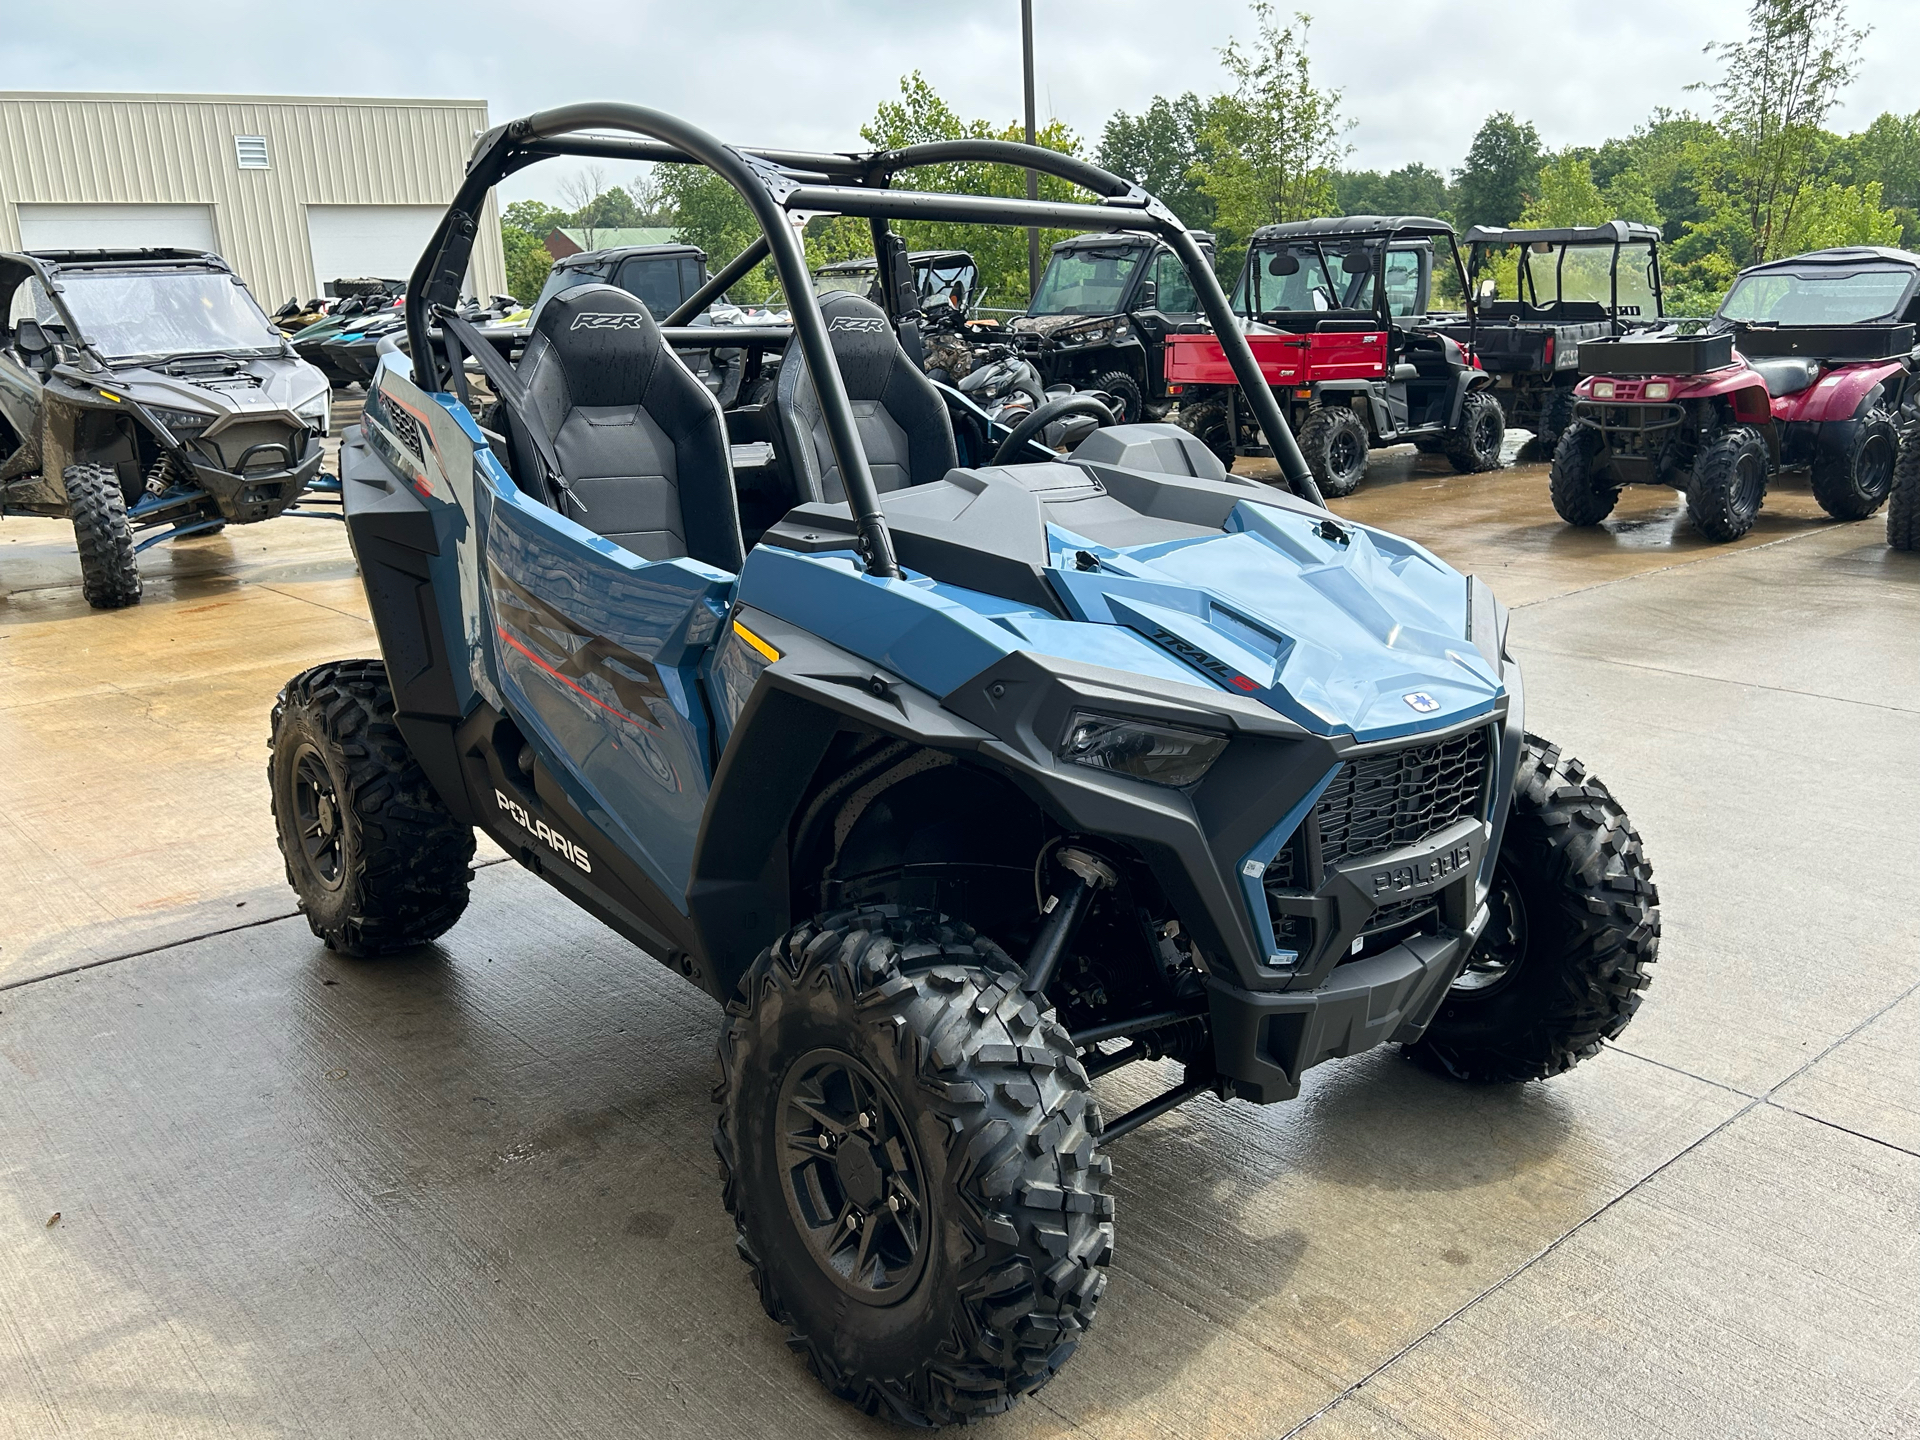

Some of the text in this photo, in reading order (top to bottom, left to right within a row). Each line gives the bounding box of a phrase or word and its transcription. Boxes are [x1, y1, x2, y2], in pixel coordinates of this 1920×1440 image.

[570, 312, 642, 331] RZR
[828, 316, 885, 333] RZR
[1152, 628, 1261, 692] TRAIL S
[494, 788, 592, 874] POLARIS
[1370, 841, 1471, 898] POLARIS
